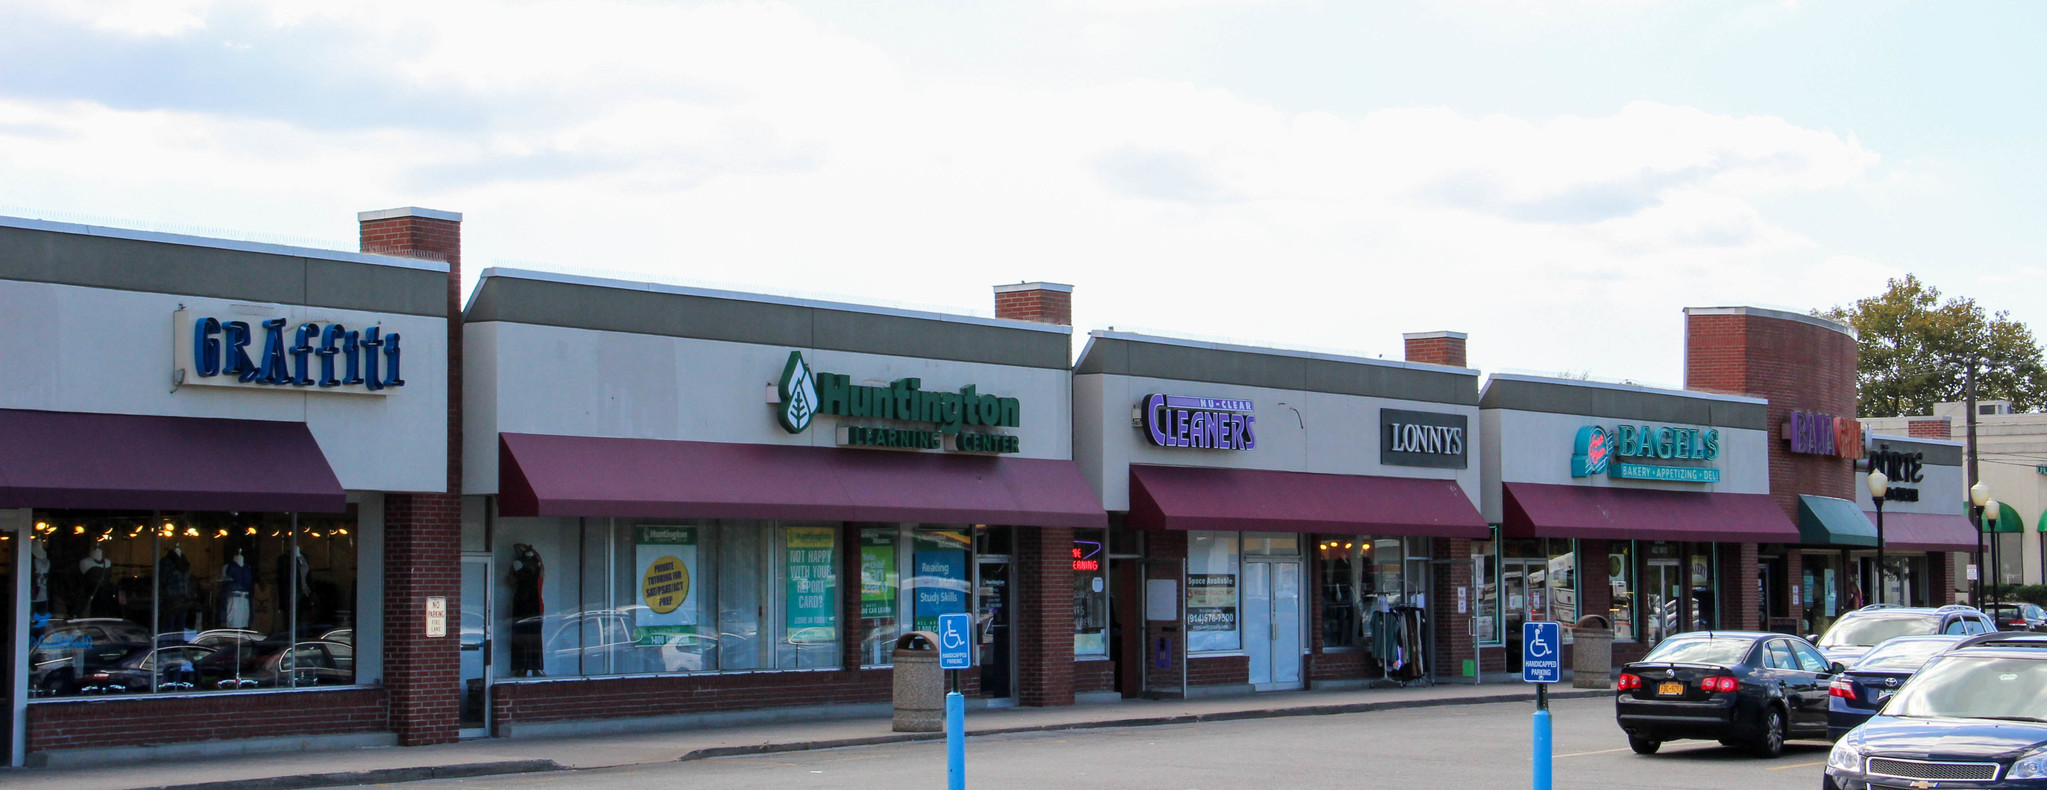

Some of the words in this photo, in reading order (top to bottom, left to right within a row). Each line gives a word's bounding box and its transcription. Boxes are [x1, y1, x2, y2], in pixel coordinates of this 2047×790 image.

[816, 372, 1020, 433] Huntington
[1199, 398, 1252, 411] NU-CLEAR
[1147, 393, 1256, 450] CLEANERS
[851, 426, 941, 449] LEARNING
[957, 432, 1020, 453] CENTER
[1391, 422, 1462, 455] LONNYS
[1792, 411, 1837, 456] BAJA
[1617, 424, 1720, 461] BAGELS
[1622, 466, 1651, 478] BAKERY
[1656, 468, 1698, 480] APPETIZING
[1703, 469, 1719, 481] DELI
[790, 551, 805, 563] NOT
[808, 550, 832, 563] HAPPY
[790, 566, 810, 578] WITH
[813, 565, 832, 578] YOUR
[921, 562, 949, 574] Reading
[648, 572, 672, 585] TUTORING
[1188, 577, 1206, 586] Space
[1206, 577, 1233, 585] Available
[797, 580, 825, 593] REPORT
[658, 596, 673, 607] PREP
[798, 595, 823, 609] CARD?
[920, 592, 939, 604] Study
[940, 591, 958, 602] Skills
[432, 600, 440, 609] NO
[1525, 660, 1557, 668] HANDICAPPED
[1530, 668, 1551, 676] PARKING
